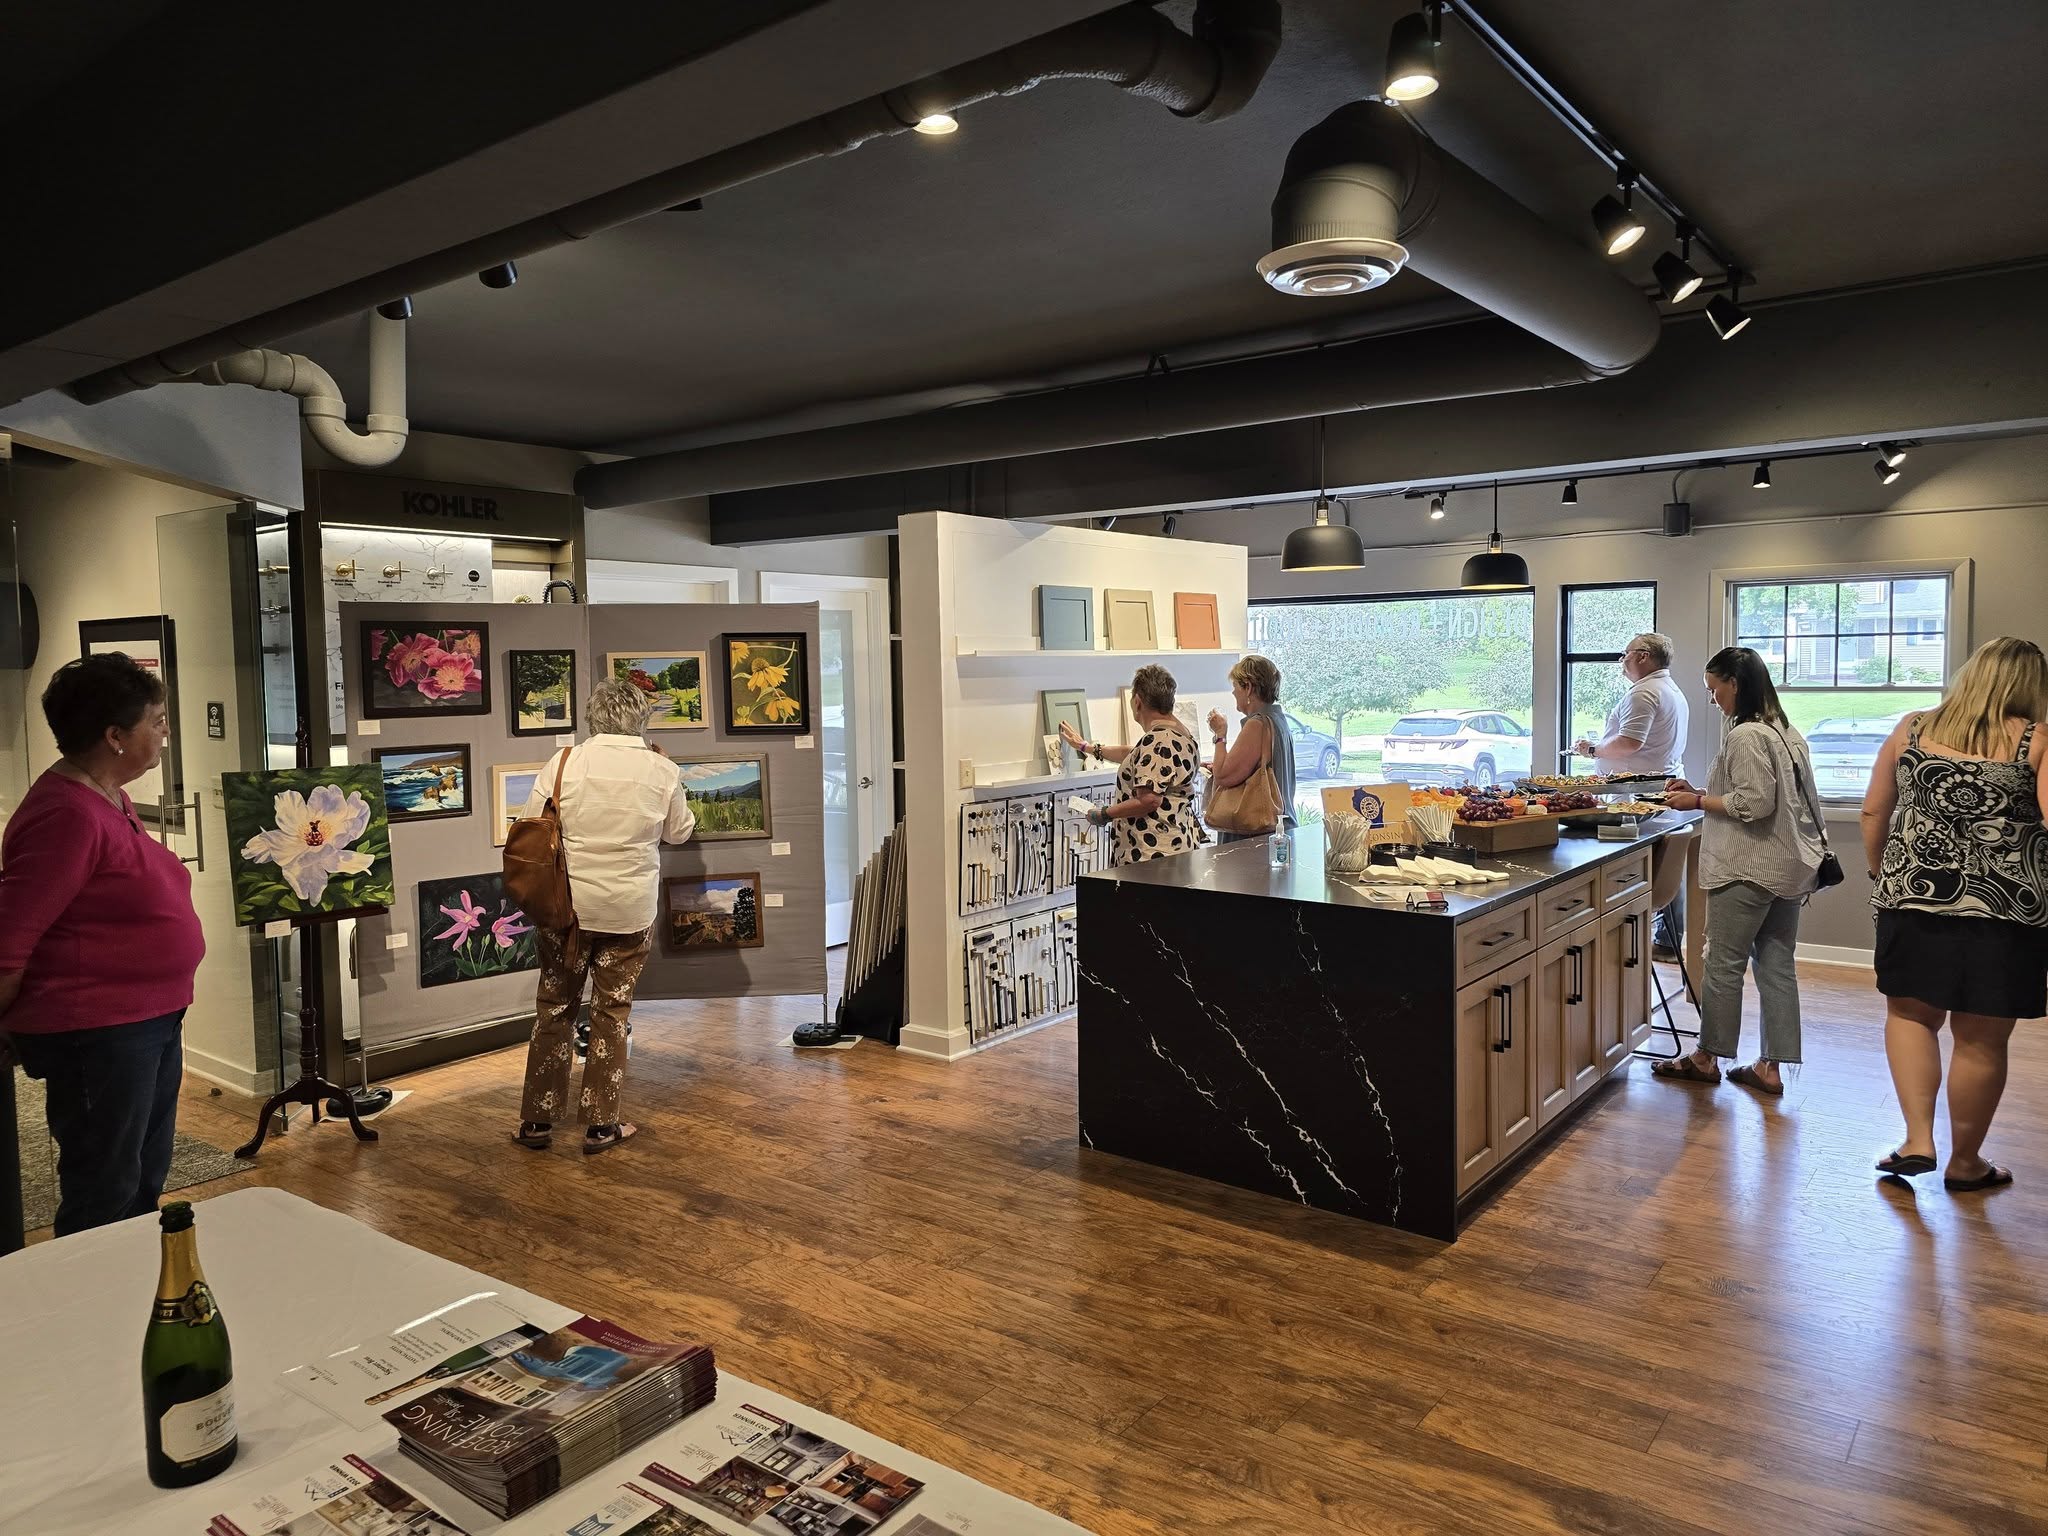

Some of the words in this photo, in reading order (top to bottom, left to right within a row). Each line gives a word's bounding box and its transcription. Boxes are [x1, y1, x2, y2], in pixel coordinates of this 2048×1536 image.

[402, 491, 498, 520] KOHLER
[1371, 832, 1401, 842] ONSIN
[401, 1404, 519, 1455] REDEFINING
[460, 1413, 533, 1441] HOME
[732, 1412, 756, 1426] WINNER
[329, 1464, 349, 1478] WINNER
